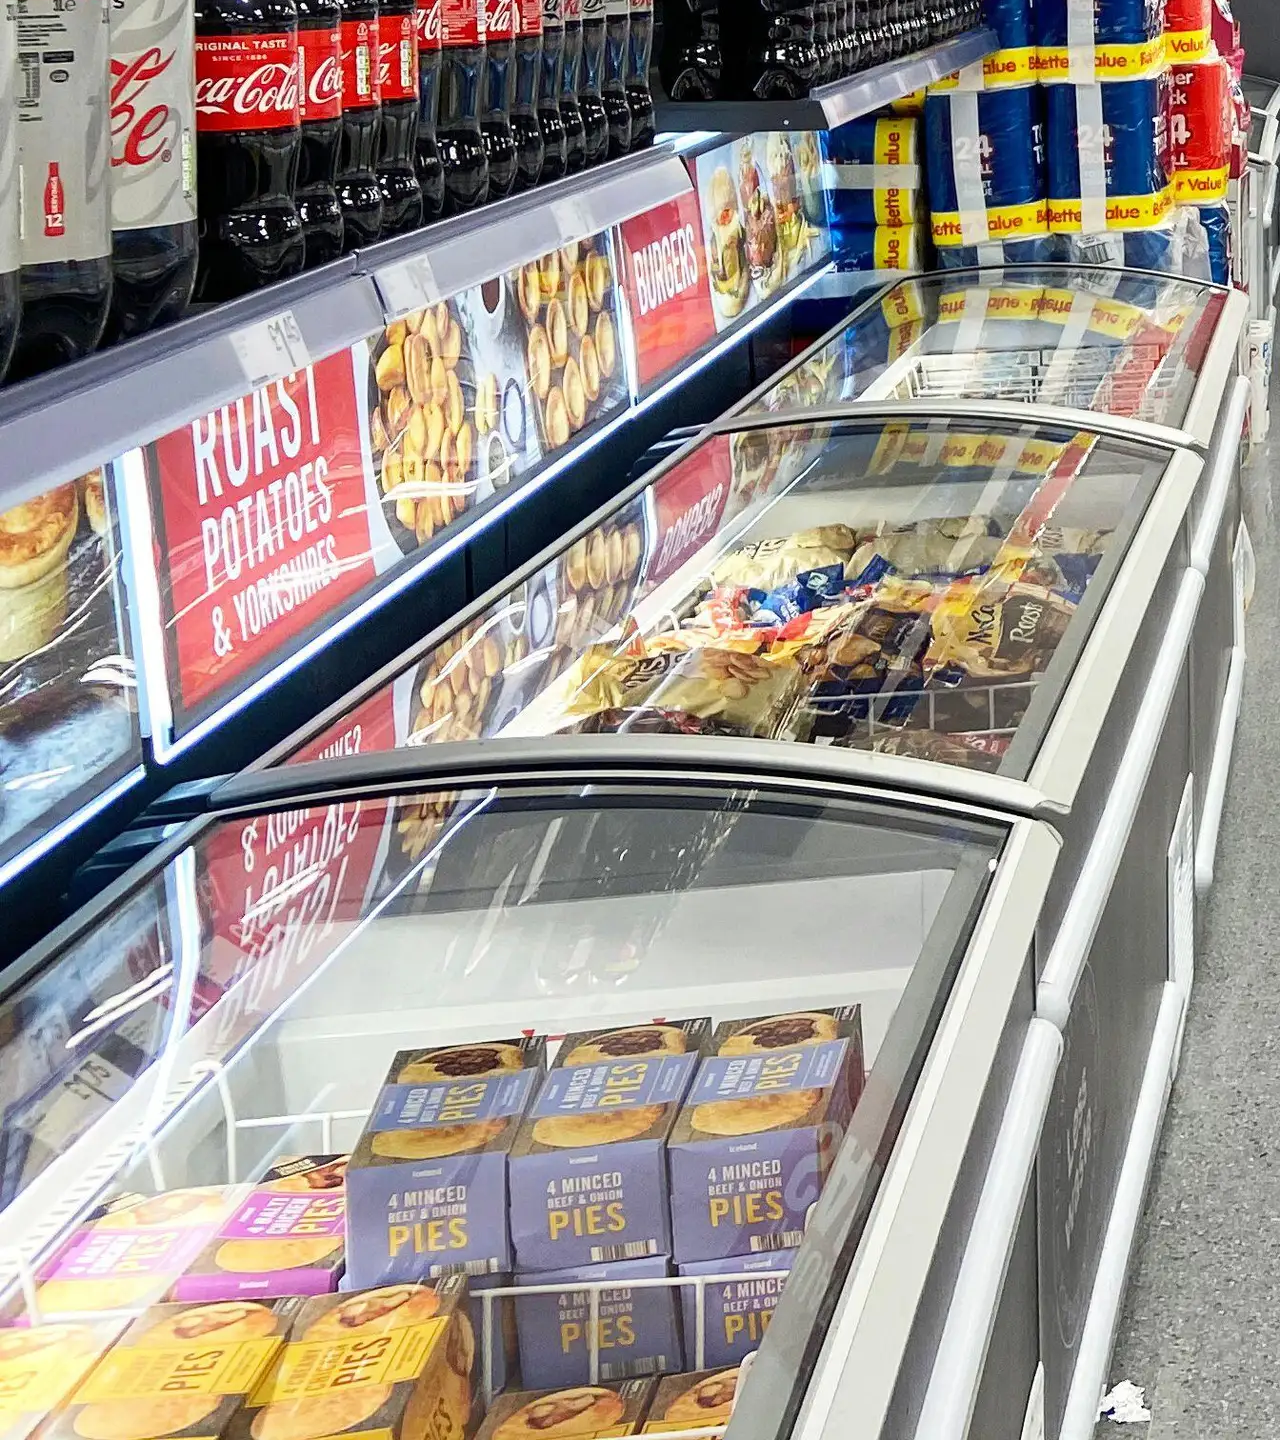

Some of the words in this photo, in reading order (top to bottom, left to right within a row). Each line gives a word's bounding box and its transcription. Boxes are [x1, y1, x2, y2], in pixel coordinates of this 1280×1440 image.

[195, 40, 249, 52] RIGINAL
[253, 39, 288, 50] TASTE
[1171, 39, 1203, 55] Value
[955, 133, 993, 158] 24
[1077, 123, 1114, 148] 24
[1186, 177, 1222, 193] Value
[45, 213, 63, 227] 12
[631, 221, 698, 317] BURGERS
[191, 364, 322, 508] ROAST
[201, 454, 333, 593] POTATOES
[212, 605, 233, 657] &
[233, 533, 339, 644] YORKSHIRES
[1009, 601, 1044, 645] Roast
[602, 1062, 648, 1104] PIES
[755, 1050, 803, 1091] PIES
[438, 1081, 488, 1122] PIES
[546, 1179, 558, 1196] 4
[561, 1171, 623, 1193] MINCED
[707, 1167, 719, 1183] 4
[720, 1159, 782, 1180] MINCED
[708, 1181, 734, 1195] BEEF
[736, 1180, 747, 1193] &
[748, 1175, 783, 1190] ONION
[290, 1195, 347, 1236] PIES
[387, 1192, 400, 1210] 4
[400, 1184, 468, 1208] MINCED
[388, 1209, 416, 1224] BEEF
[418, 1208, 429, 1222] &
[431, 1203, 468, 1219] ONION
[547, 1195, 573, 1209] BEEF
[575, 1194, 585, 1207] &
[587, 1188, 623, 1203] ONION
[708, 1191, 785, 1227] PIES
[387, 1217, 469, 1258] PIES
[548, 1201, 627, 1240] PIES
[161, 1348, 225, 1393] PIES
[330, 1334, 392, 1388] PIES
